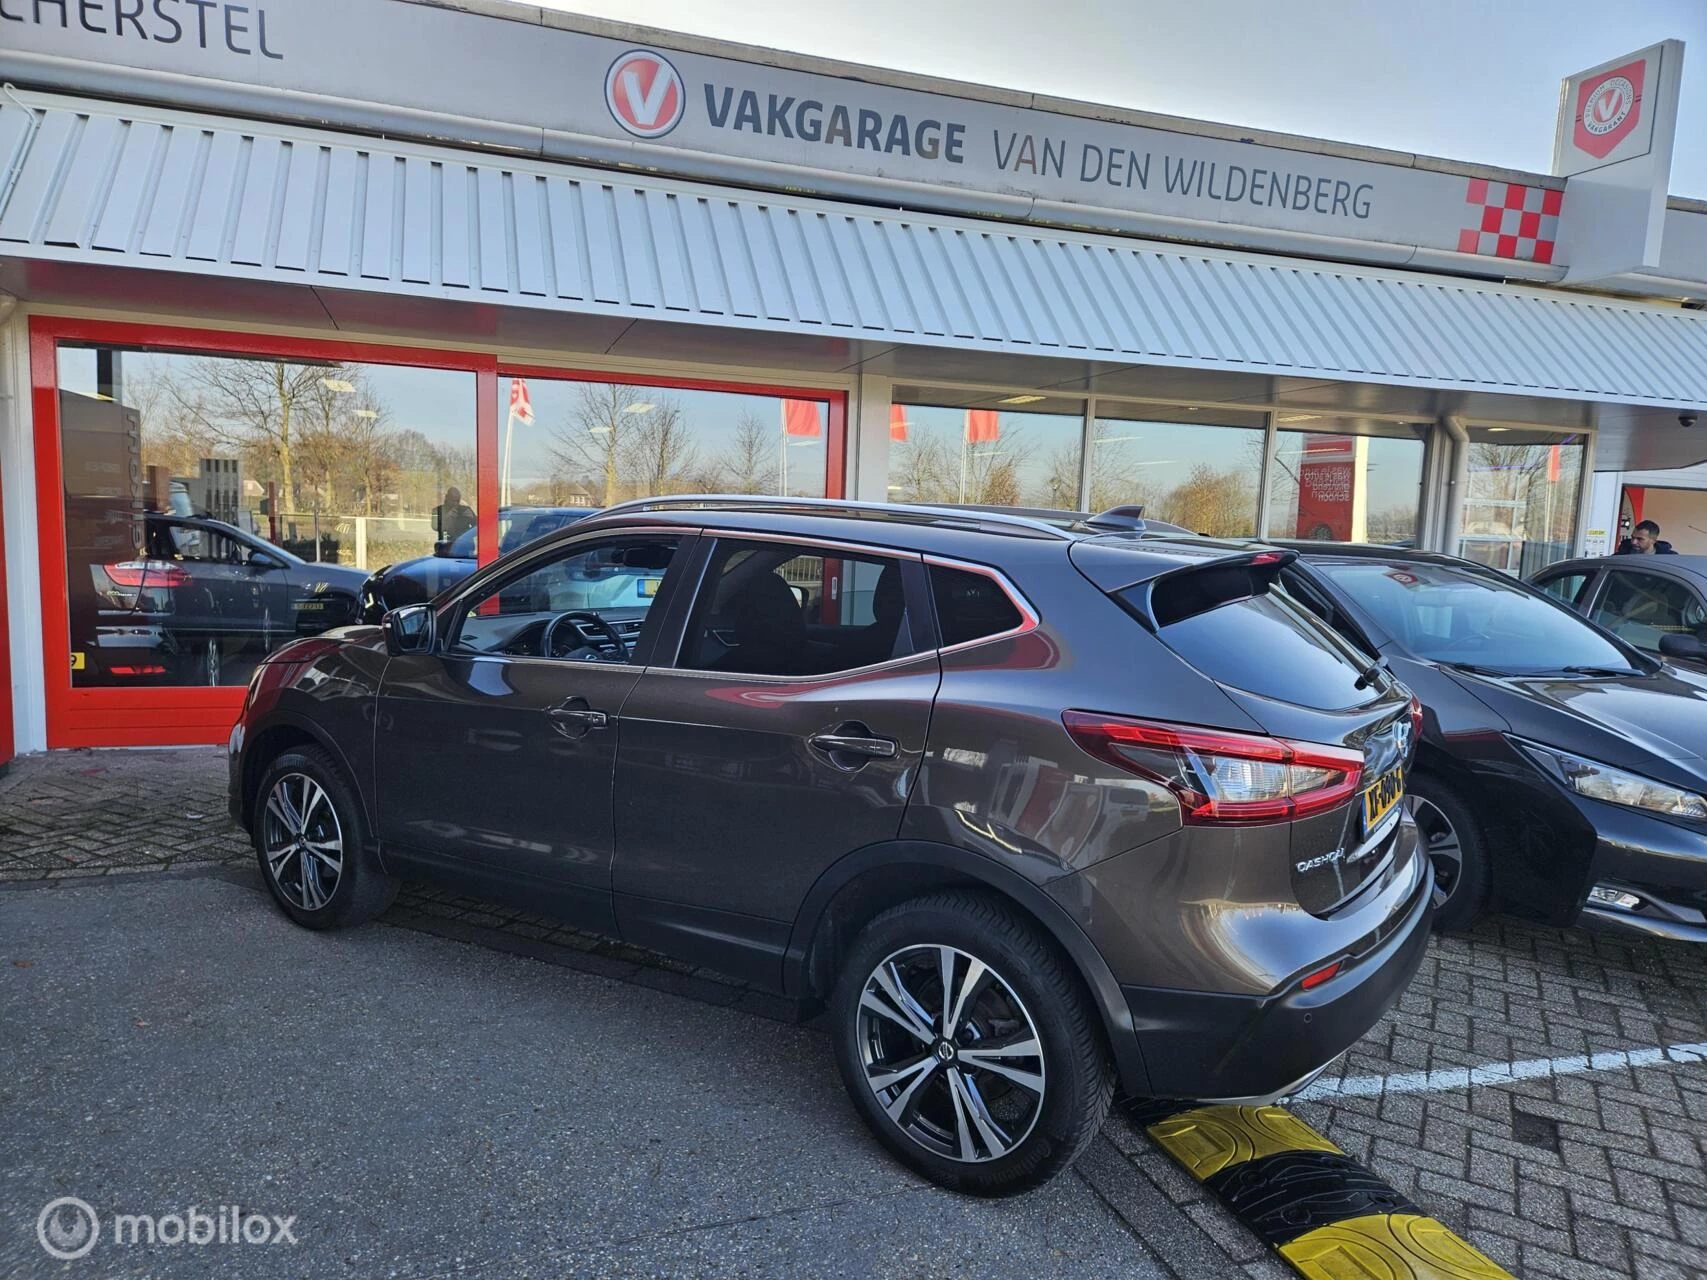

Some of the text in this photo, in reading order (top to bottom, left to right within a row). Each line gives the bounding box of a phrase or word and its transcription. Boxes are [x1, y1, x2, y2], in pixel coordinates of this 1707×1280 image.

[704, 83, 1374, 219] VAKGARAGE VAN DEN WILDENBERG
